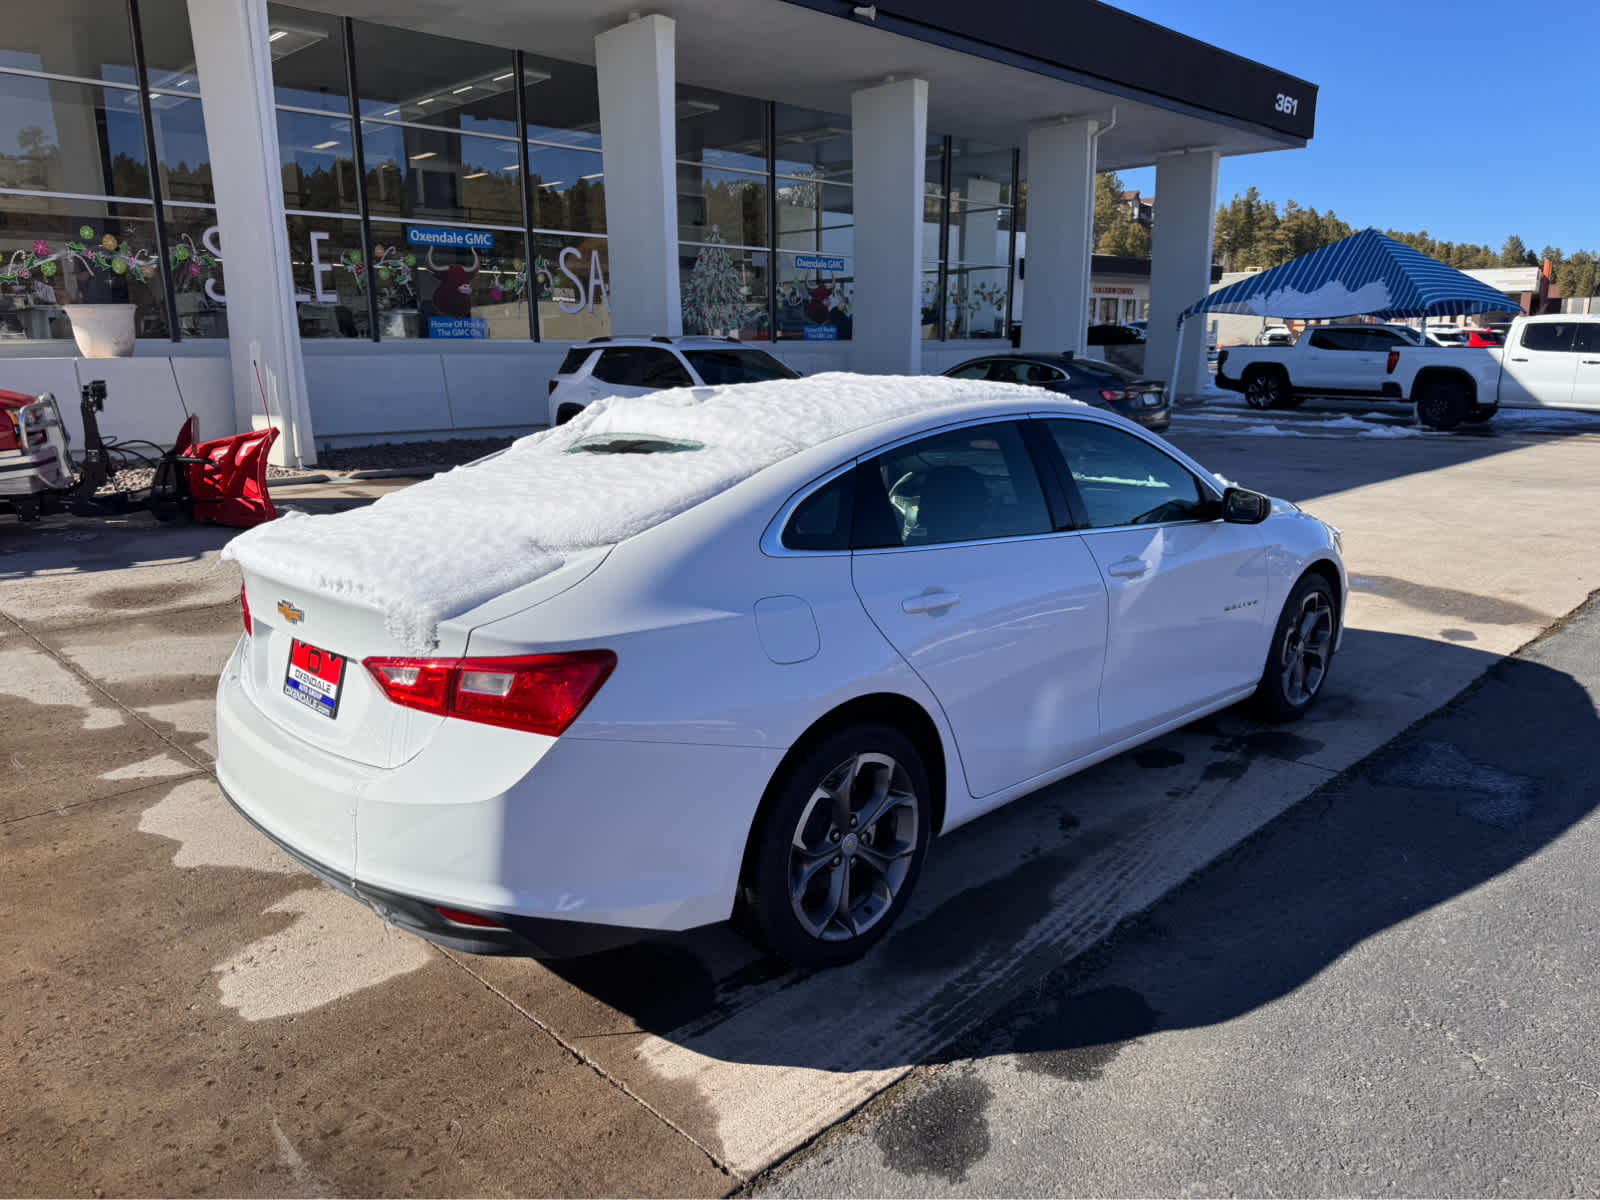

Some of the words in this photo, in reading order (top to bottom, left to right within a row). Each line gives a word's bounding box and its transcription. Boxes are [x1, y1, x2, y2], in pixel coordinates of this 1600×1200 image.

[1275, 92, 1298, 116] 361
[410, 229, 463, 244] Oxendale
[465, 233, 492, 245] GMC
[451, 328, 470, 337] GMC
[294, 669, 332, 695] OXENDALE
